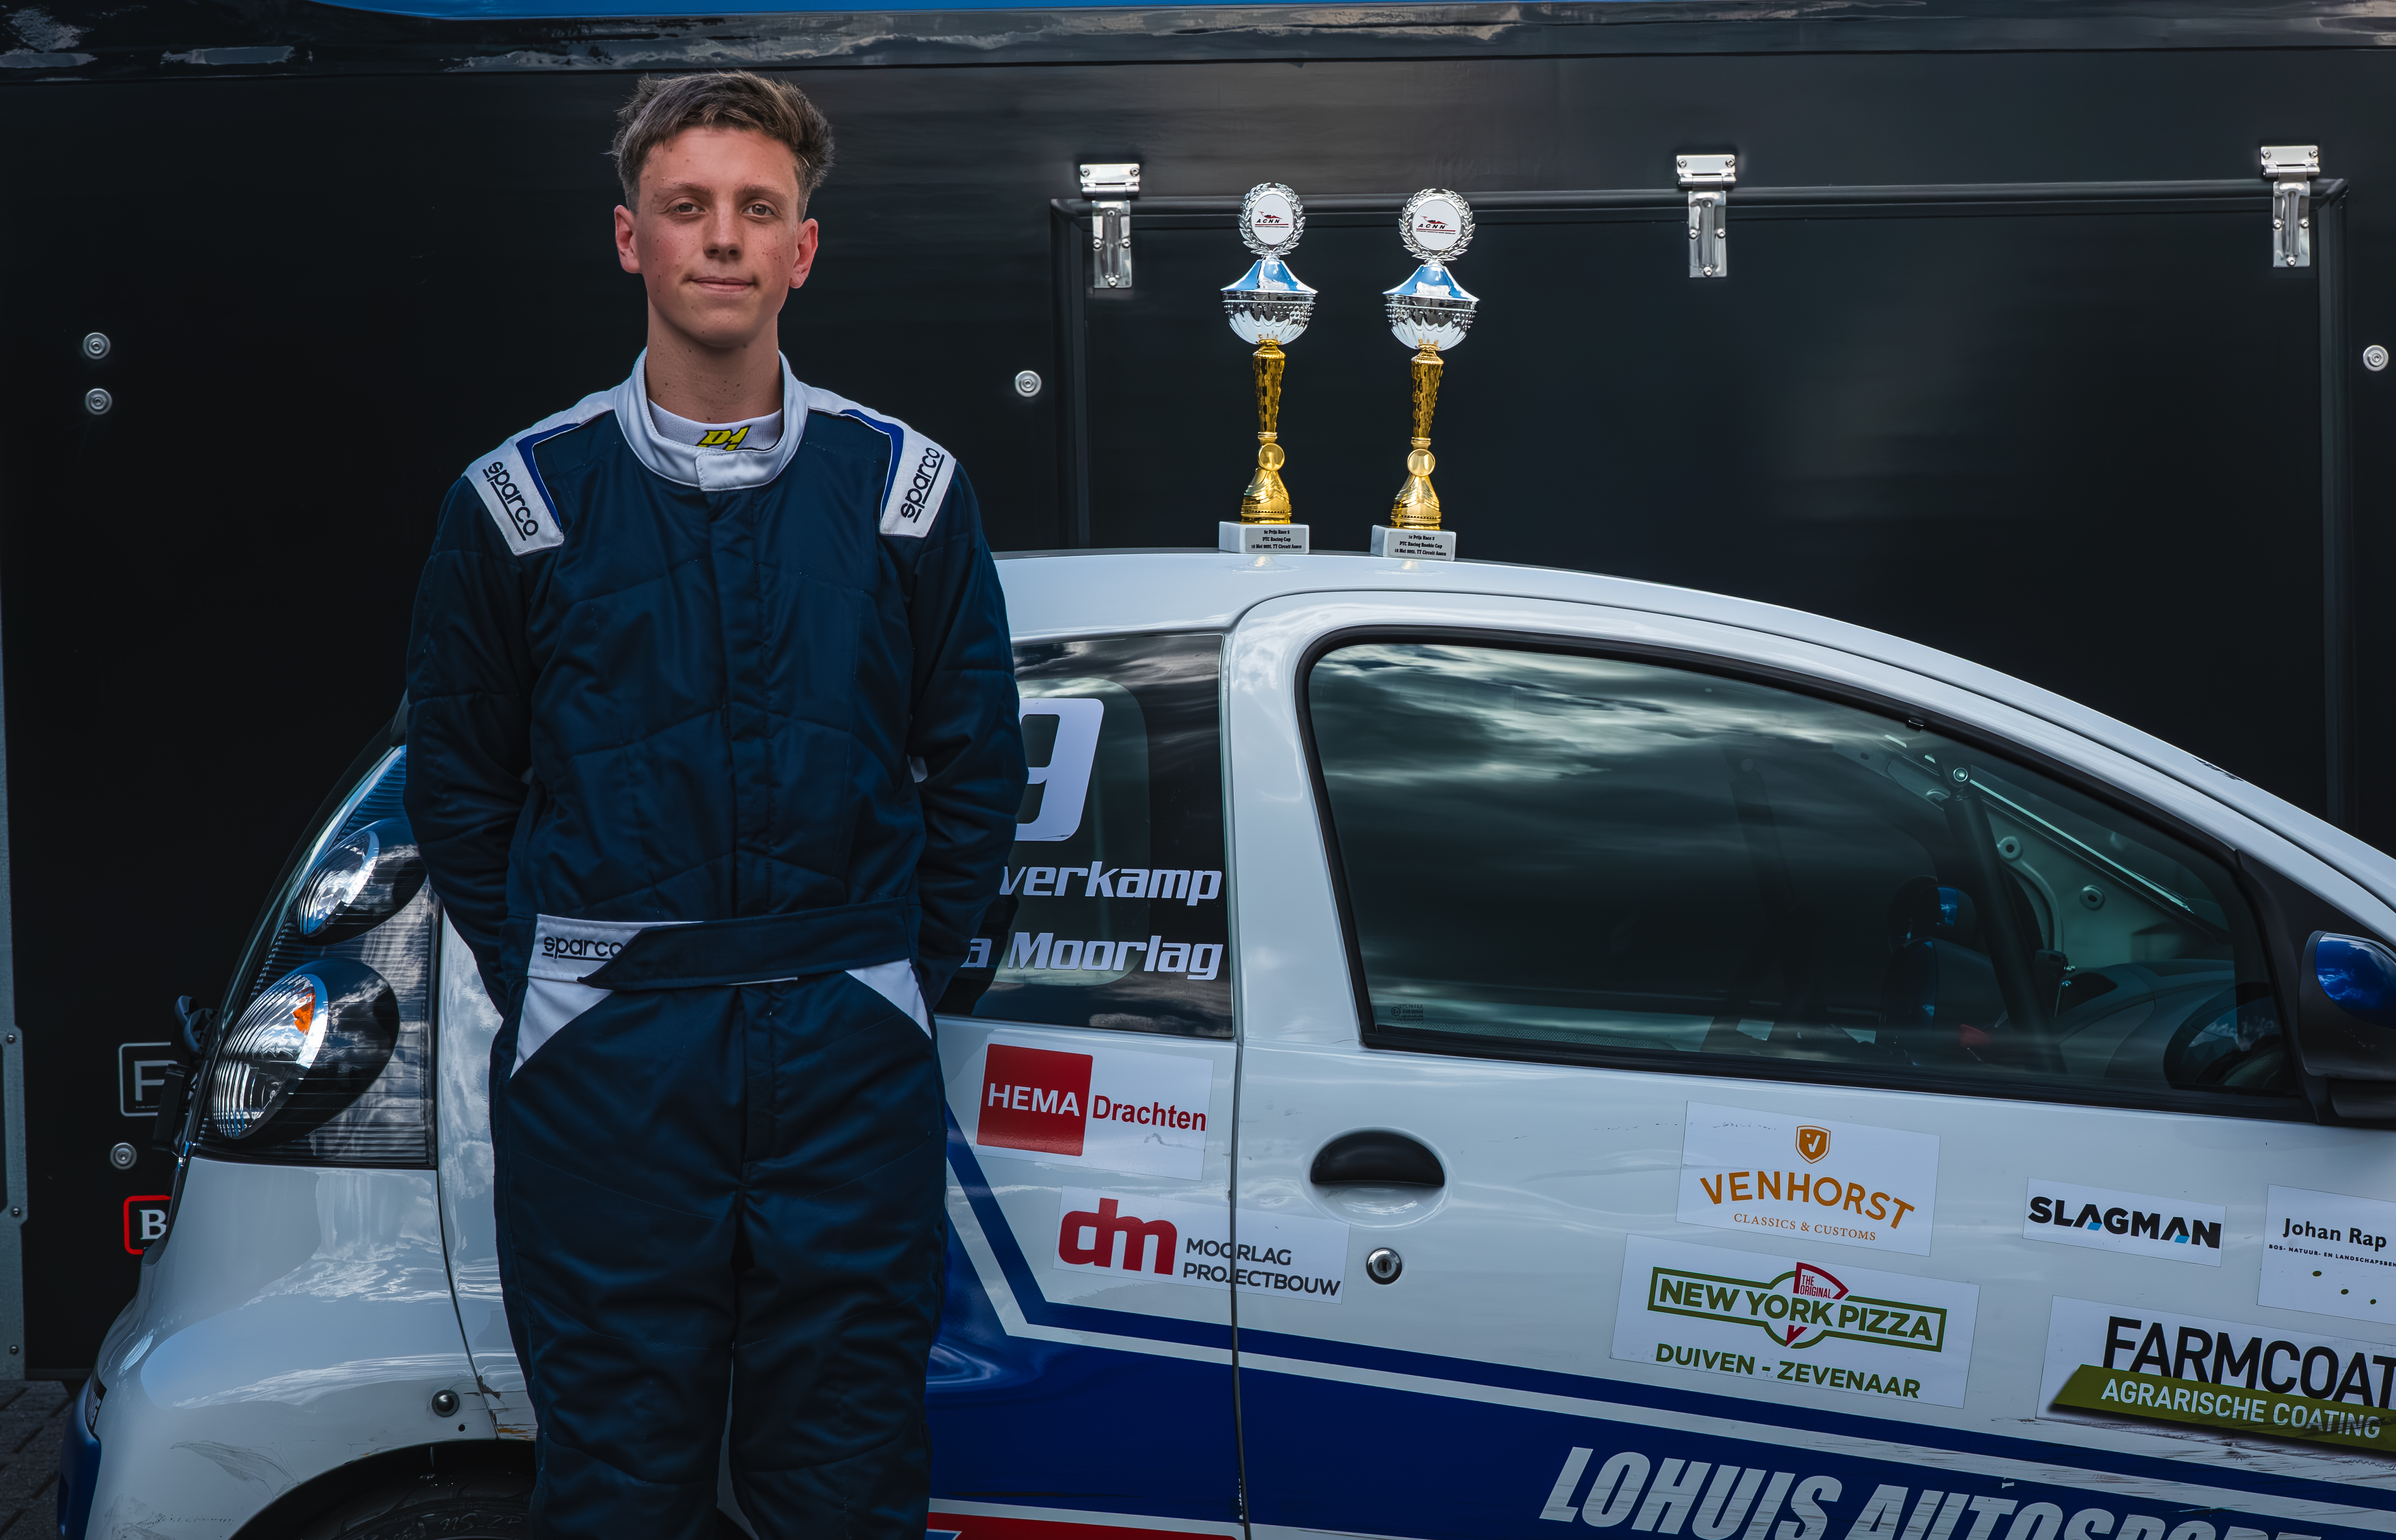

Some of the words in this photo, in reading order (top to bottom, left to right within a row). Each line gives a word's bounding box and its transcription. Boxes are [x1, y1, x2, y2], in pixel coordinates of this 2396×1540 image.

[482, 461, 539, 542] sparco
[900, 446, 946, 524] sparco
[1015, 698, 1104, 841] 9
[542, 936, 623, 960] sparco
[1008, 932, 1223, 980] Moorlag
[987, 1083, 1080, 1116] HEMA
[1092, 1095, 1206, 1132] Drachten
[1699, 1171, 1915, 1229] VENHORST
[2028, 1196, 2221, 1249] SLAGMAN
[1059, 1197, 1177, 1275] dm
[1186, 1238, 1292, 1265] MOORLAG
[1734, 1213, 1796, 1230] CLASSICS
[1801, 1222, 1811, 1232] &
[1815, 1224, 1876, 1241] CUSTOMS
[2282, 1218, 2341, 1241] Johan
[2349, 1227, 2387, 1252] Rap
[2288, 1247, 2321, 1256] NATUUR-
[1183, 1262, 1341, 1296] PROECTBOUW
[1800, 1285, 1831, 1299] ORIGINAL
[1802, 1275, 1815, 1286] THE
[1659, 1278, 1740, 1312] NEW
[1744, 1290, 1835, 1327] YORK
[1839, 1305, 1932, 1341] PIZZA
[1655, 1343, 1755, 1375] DUIVEN
[1777, 1361, 1920, 1399] ZEVENAAR
[2103, 1316, 2396, 1409] FARMCOAT
[2101, 1378, 2267, 1423] AGRARISCHE
[2273, 1403, 2380, 1439] COATING
[1539, 1446, 1841, 1540] LOHUIS
[1844, 1484, 2322, 1540] AUTOS
